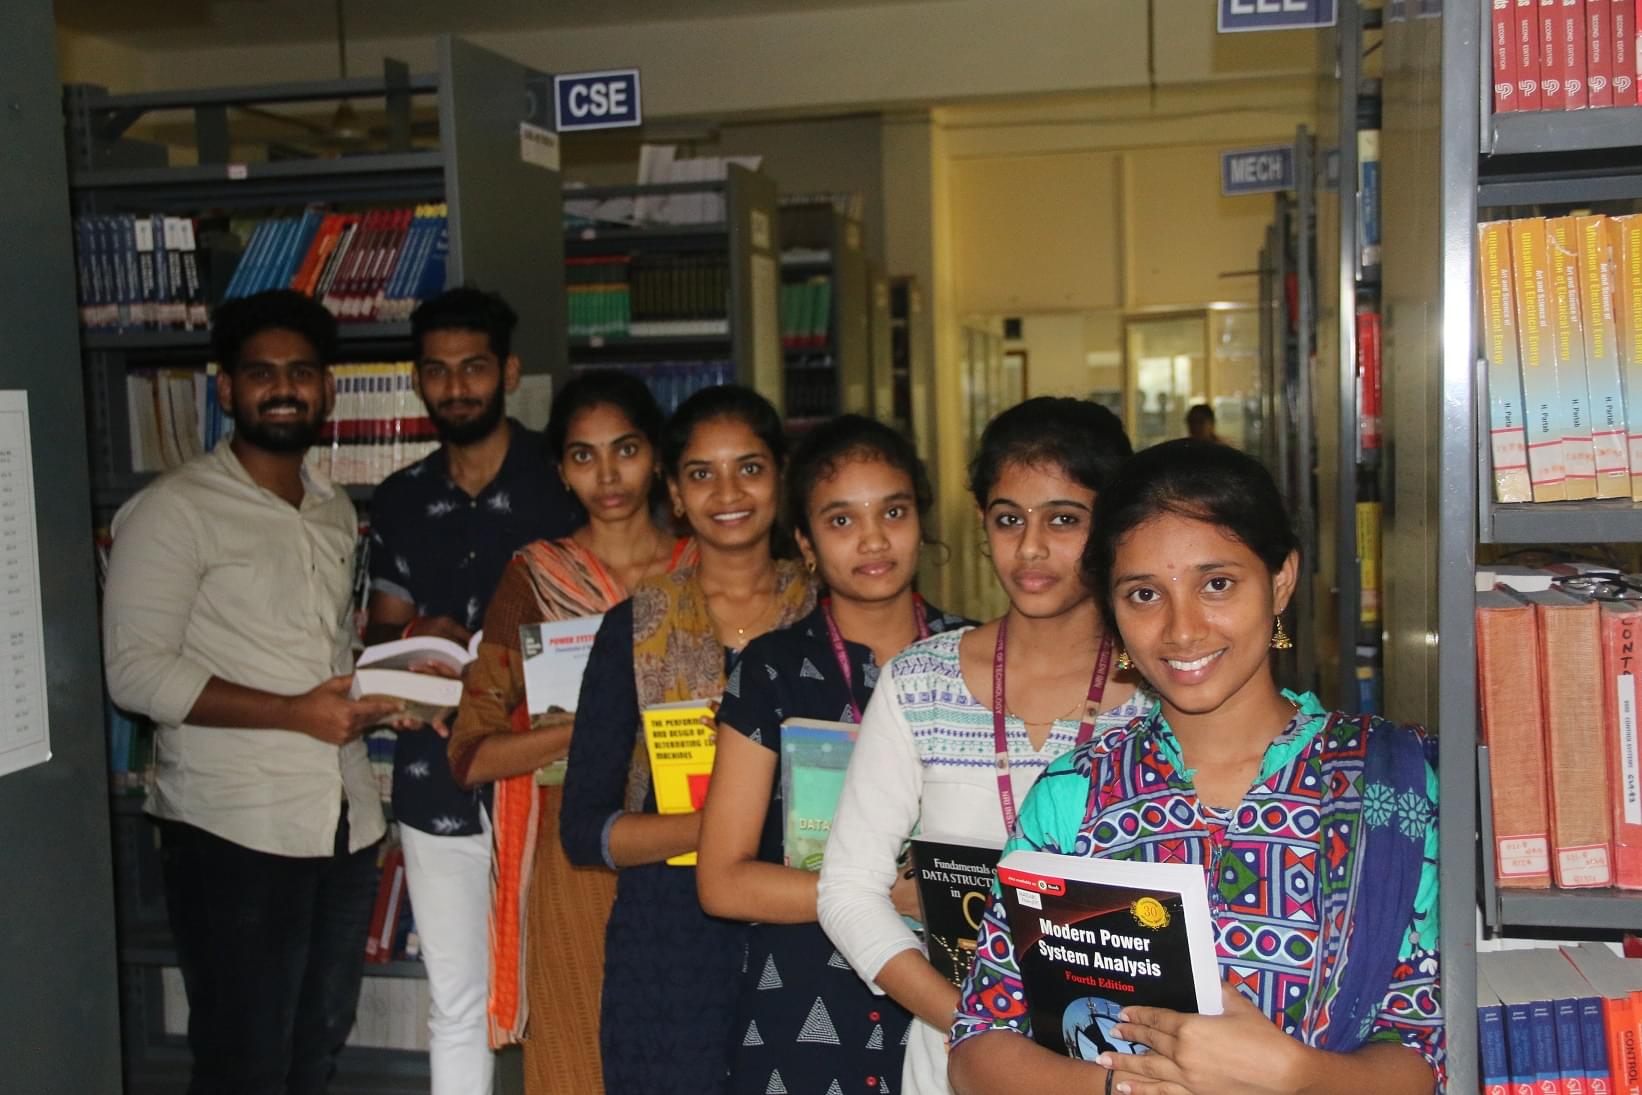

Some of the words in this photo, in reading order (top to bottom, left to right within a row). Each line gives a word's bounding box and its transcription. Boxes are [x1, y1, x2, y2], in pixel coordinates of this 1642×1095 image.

[1521, 20, 1529, 42] SECOND
[1522, 45, 1530, 67] EDITION
[1592, 41, 1600, 63] EDITION
[568, 81, 628, 118] CSE
[1230, 154, 1282, 184] MECH
[1488, 231, 1499, 277] Utilisation
[1521, 233, 1533, 277] Utilisation
[1586, 226, 1597, 270] Utilisation
[1631, 229, 1641, 275] Utilisation
[1535, 270, 1543, 279] Art
[1566, 266, 1574, 275] Art
[1600, 263, 1608, 272] Art
[1601, 274, 1609, 285] and
[1492, 279, 1501, 287] of
[1536, 281, 1544, 292] and
[1556, 276, 1565, 284] of
[1567, 277, 1575, 288] and
[1633, 277, 1641, 285] of
[1492, 290, 1502, 333] Electrical
[1537, 293, 1545, 319] Science
[1558, 287, 1569, 329] Electrical
[1568, 290, 1576, 314] Science
[1590, 284, 1602, 326] Electrical
[1602, 287, 1610, 312] Science
[1633, 288, 1642, 331] Electrical
[1526, 291, 1538, 334] Electrical
[1494, 335, 1504, 365] Energy
[1527, 336, 1539, 366] Energy
[1560, 332, 1570, 360] Energy
[1594, 329, 1604, 358] Energy
[1541, 413, 1549, 432] Partab
[1573, 407, 1581, 428] Partab
[549, 636, 573, 645] POWER
[995, 663, 1003, 715] TECHNOLOGY
[655, 740, 701, 748] ALTERNATING
[800, 818, 831, 832] DATA
[934, 858, 990, 874] Fundamentals
[922, 869, 951, 882] DATA
[951, 873, 994, 888] STRUCT
[951, 886, 961, 898] in
[962, 891, 986, 932] C
[1143, 905, 1158, 918] 30
[1039, 919, 1096, 944] Modern
[1100, 929, 1150, 951] Power
[1038, 940, 1089, 966] System
[1094, 952, 1161, 977] Analysis
[1064, 970, 1096, 986] Fourth
[1099, 975, 1135, 992] Edition
[1625, 1031, 1637, 1084] CONTROL
